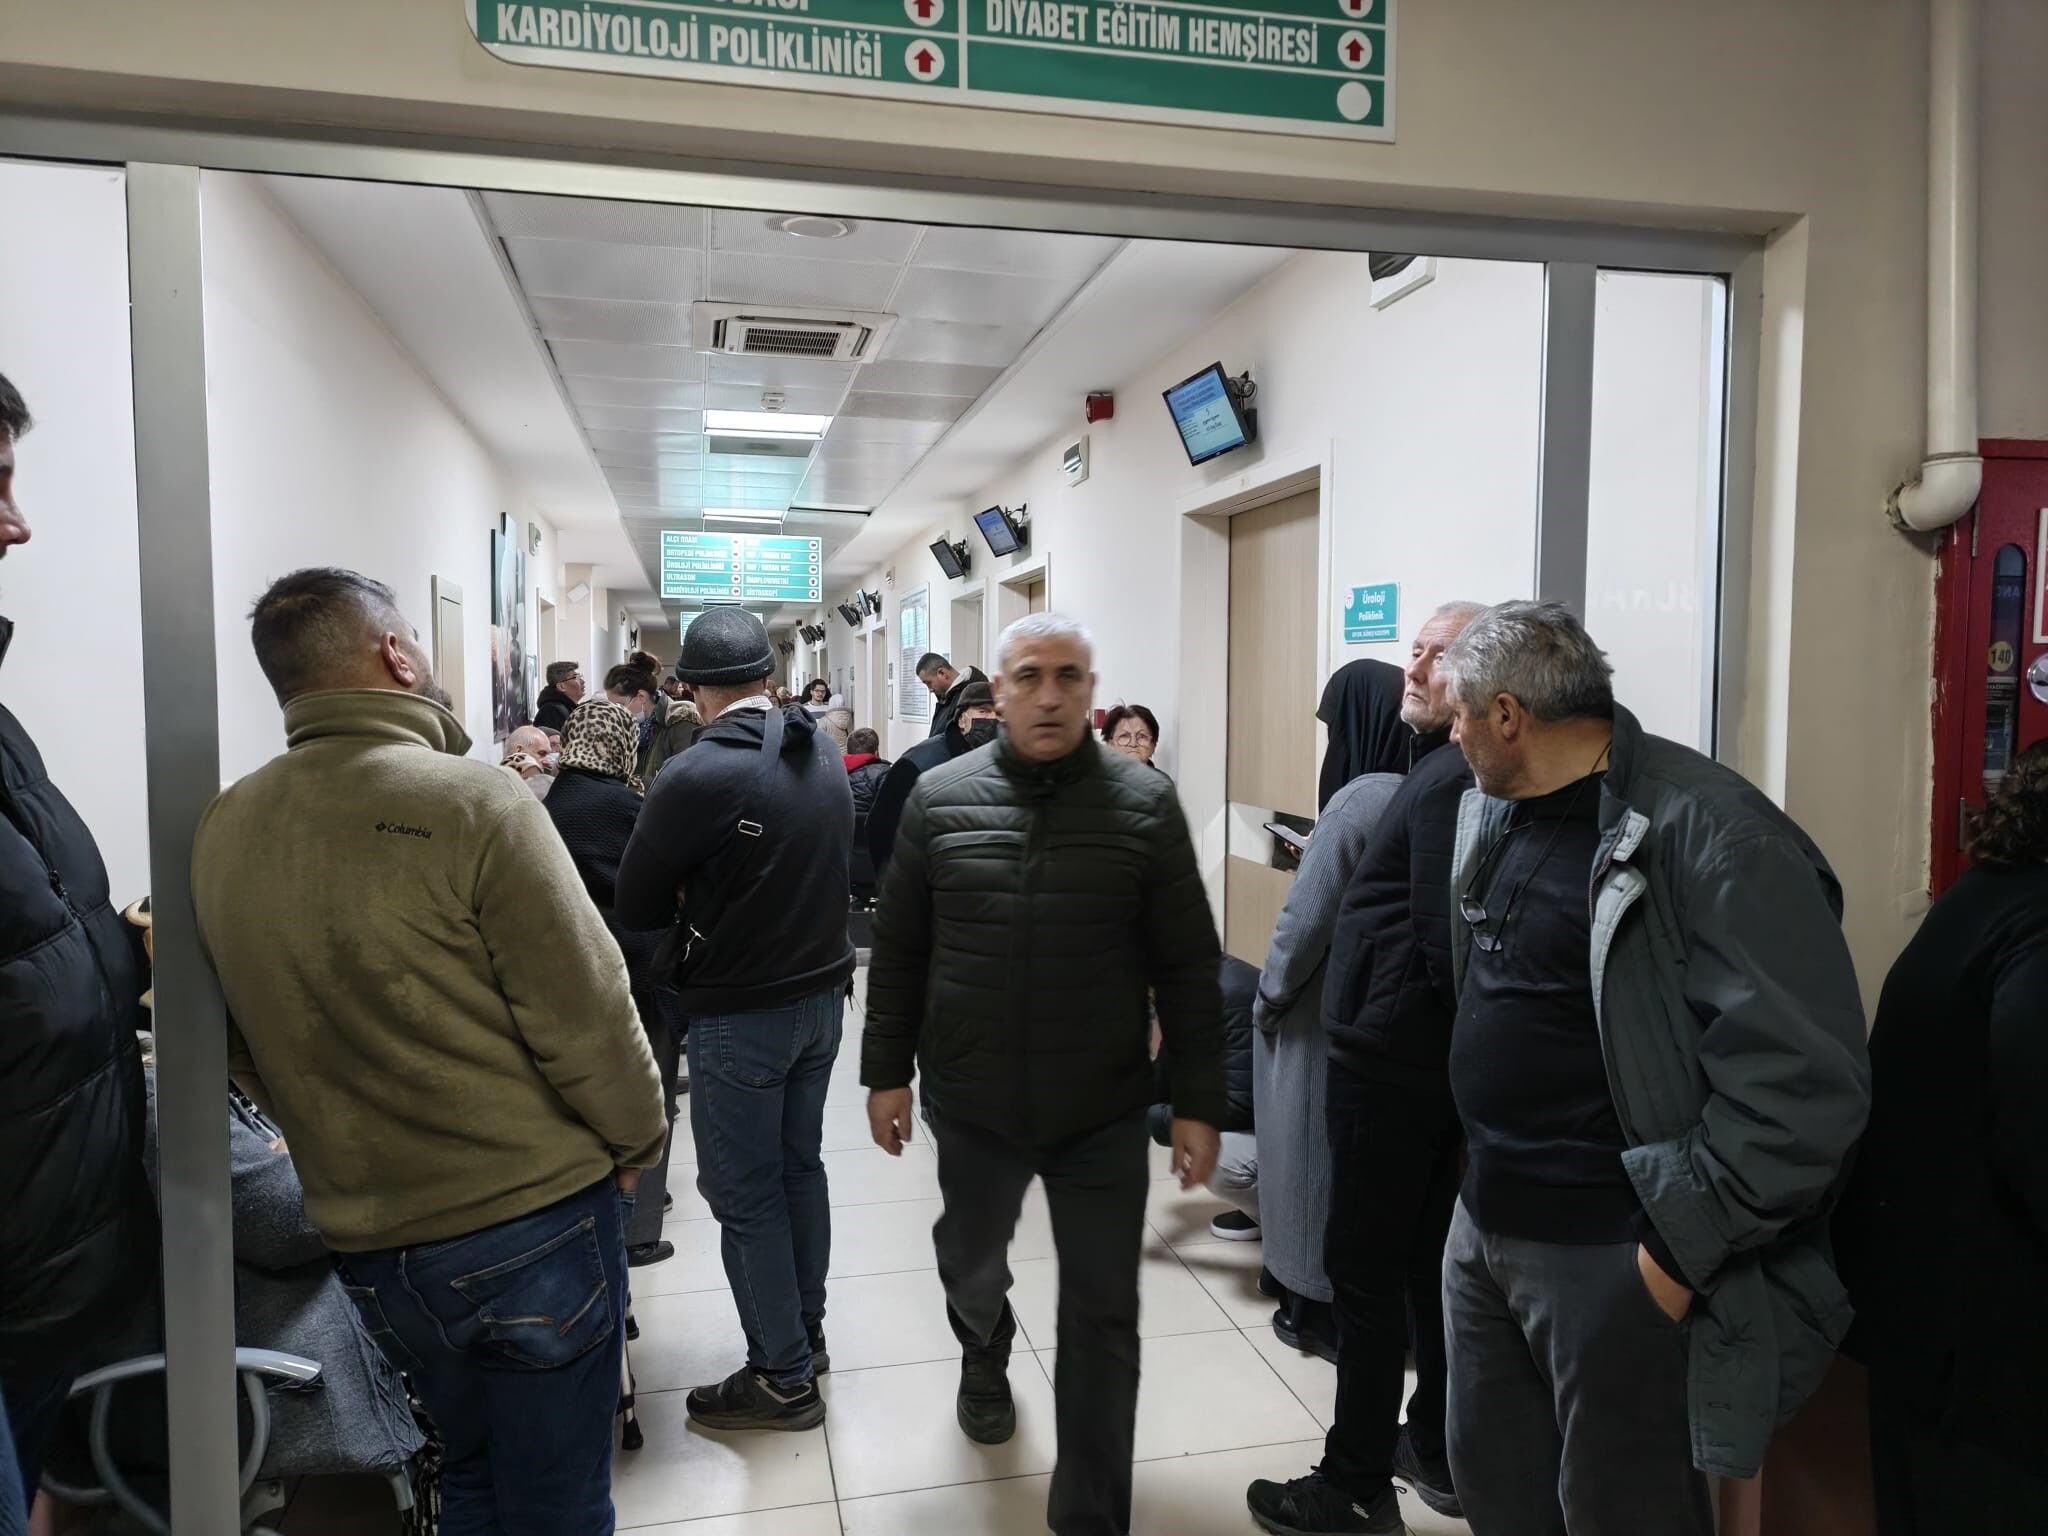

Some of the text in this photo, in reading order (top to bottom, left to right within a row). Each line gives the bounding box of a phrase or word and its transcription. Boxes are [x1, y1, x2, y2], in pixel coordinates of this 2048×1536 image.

[497, 3, 882, 78] KARDİYOLOJİ POLİKLİNİĞİ
[1096, 0, 1180, 50] EĞİTİM
[1188, 16, 1318, 64] HEMŞİRESİ
[1991, 648, 2011, 665] 140
[387, 823, 432, 839] Columbia
